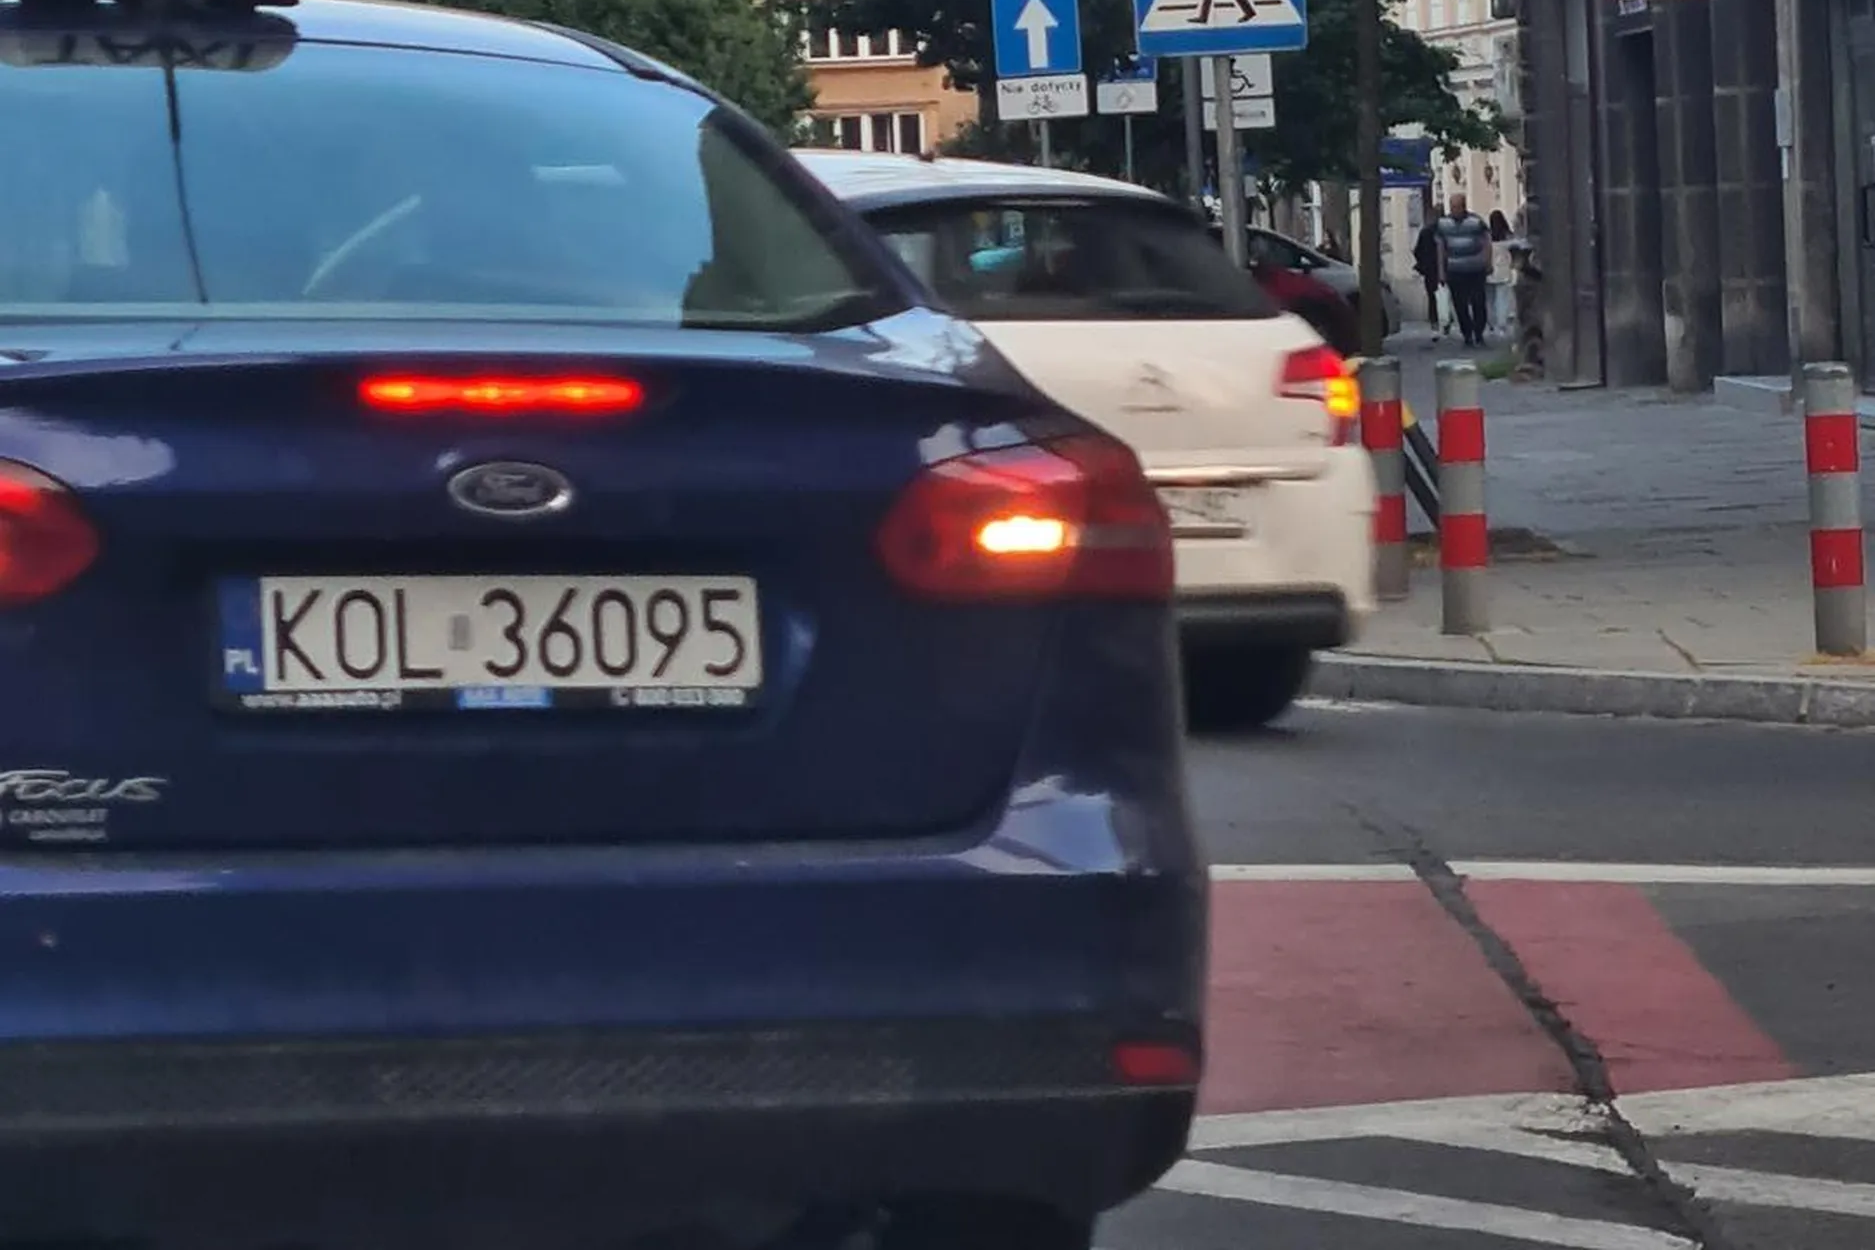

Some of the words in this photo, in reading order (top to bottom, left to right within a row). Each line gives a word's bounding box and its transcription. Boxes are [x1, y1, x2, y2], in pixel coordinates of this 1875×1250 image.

[222, 648, 259, 675] PL
[271, 588, 443, 681] KOL
[481, 587, 747, 679] 36095
